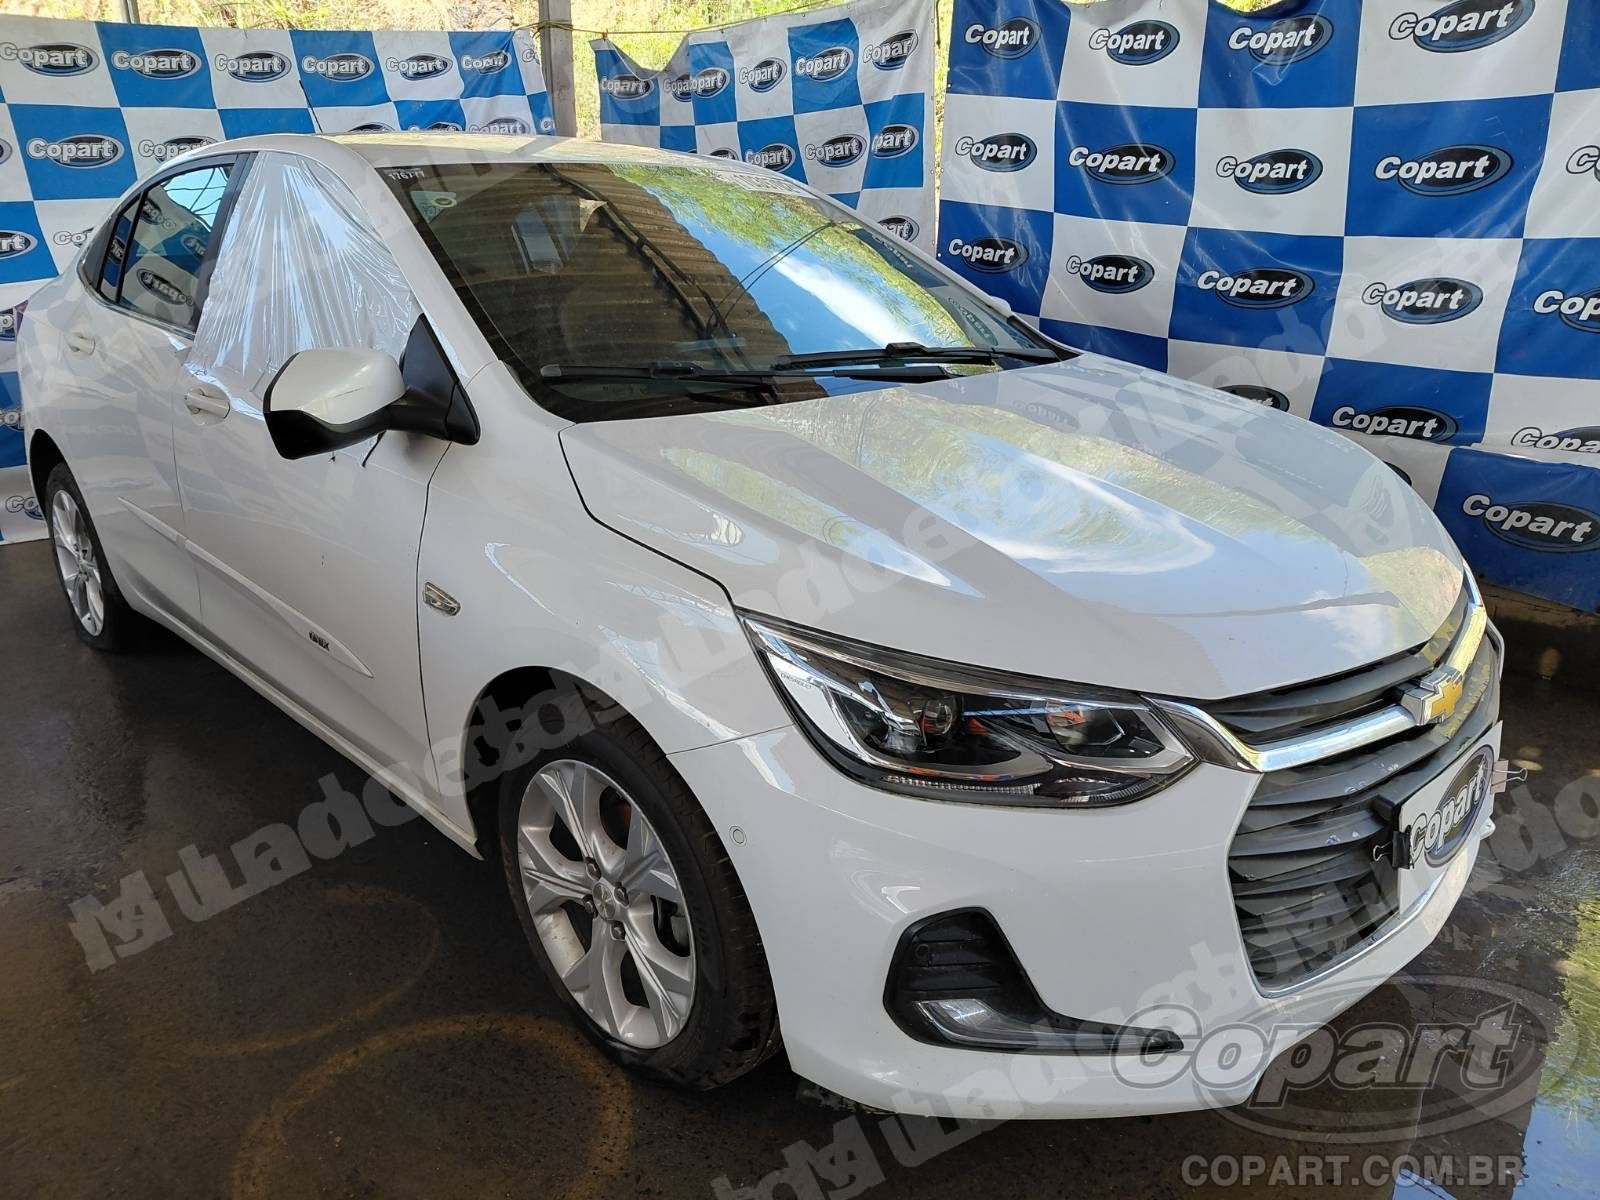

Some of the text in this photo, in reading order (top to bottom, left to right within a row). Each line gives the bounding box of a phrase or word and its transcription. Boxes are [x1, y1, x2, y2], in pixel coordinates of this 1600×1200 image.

[1389, 2, 1514, 41] Copart
[965, 24, 1029, 48] Copart
[1089, 28, 1166, 53] Copart
[1228, 24, 1315, 53] Copart
[0, 42, 88, 68] Copart
[112, 51, 192, 72] Copart
[215, 54, 282, 74] Copart
[302, 56, 366, 77] Copart
[385, 57, 445, 77] Copart
[794, 51, 849, 79] Copart
[600, 76, 648, 93] Copart
[738, 61, 780, 86] Copart
[26, 138, 113, 163] Copart
[804, 136, 863, 161] Copart
[955, 136, 1026, 161] Copart
[1068, 147, 1161, 173] Copart
[1216, 156, 1307, 183] Copart
[1375, 154, 1490, 183] Copart
[948, 238, 1015, 264] Copart
[1066, 256, 1139, 283] Copart
[1197, 269, 1297, 297] Copart
[1362, 282, 1465, 310] Copart
[1332, 406, 1440, 439] Copart
[1462, 494, 1594, 543] Copart
[1410, 755, 1487, 865] Copart
